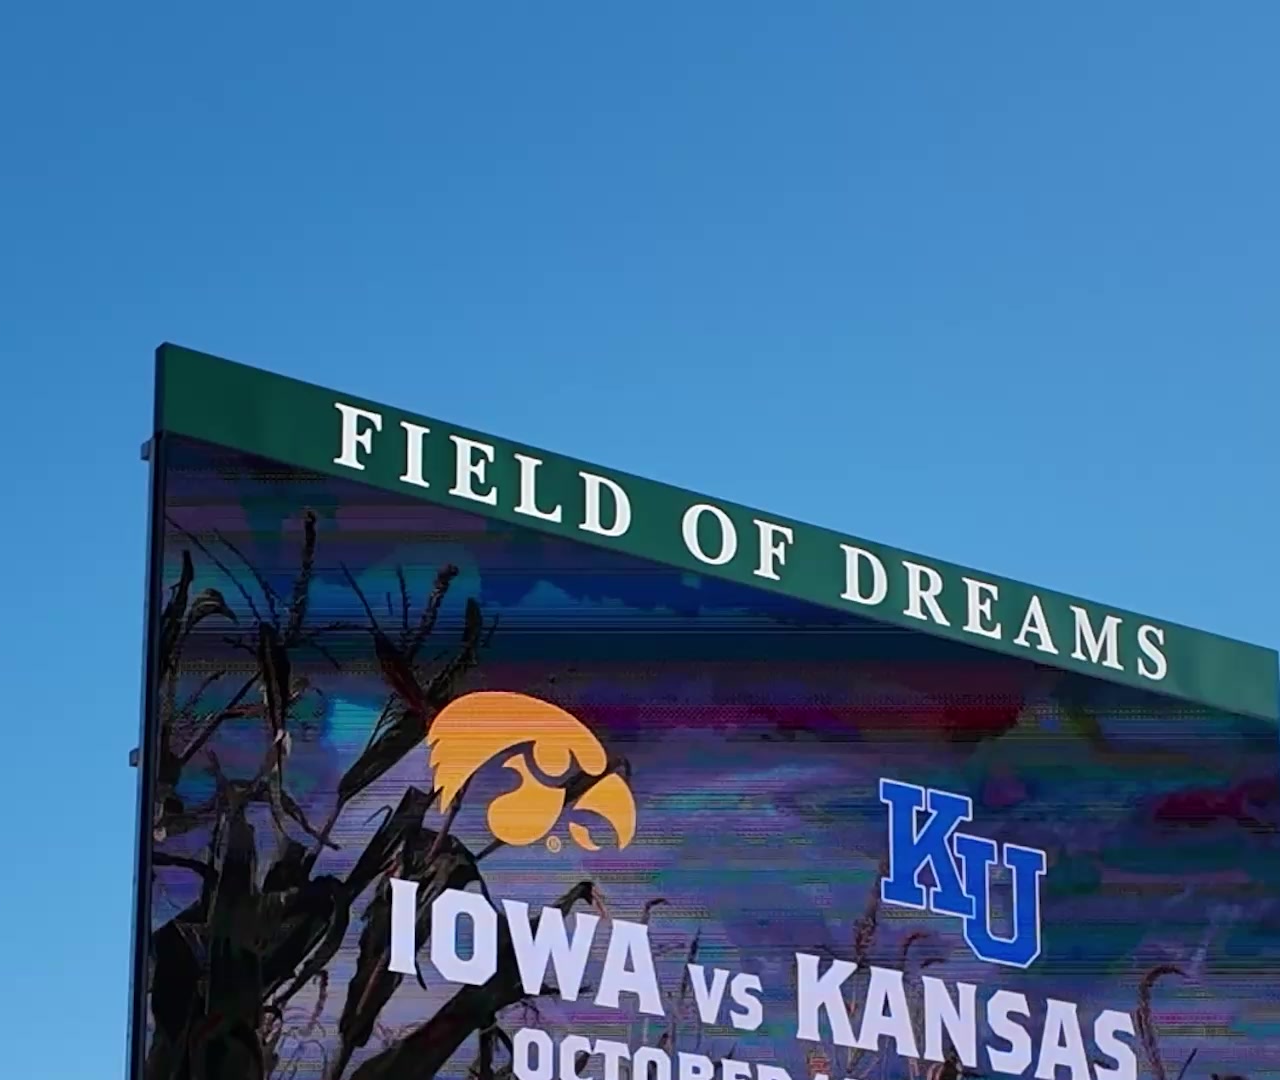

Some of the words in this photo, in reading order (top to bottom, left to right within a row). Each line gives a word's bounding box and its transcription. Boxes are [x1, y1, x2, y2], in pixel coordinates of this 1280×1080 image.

[333, 402, 632, 537] FIELD
[682, 503, 794, 580] OF
[840, 543, 1169, 681] DREAMS
[388, 877, 665, 1017] IOWA
[687, 962, 763, 1031] VS
[880, 778, 1046, 968] KU
